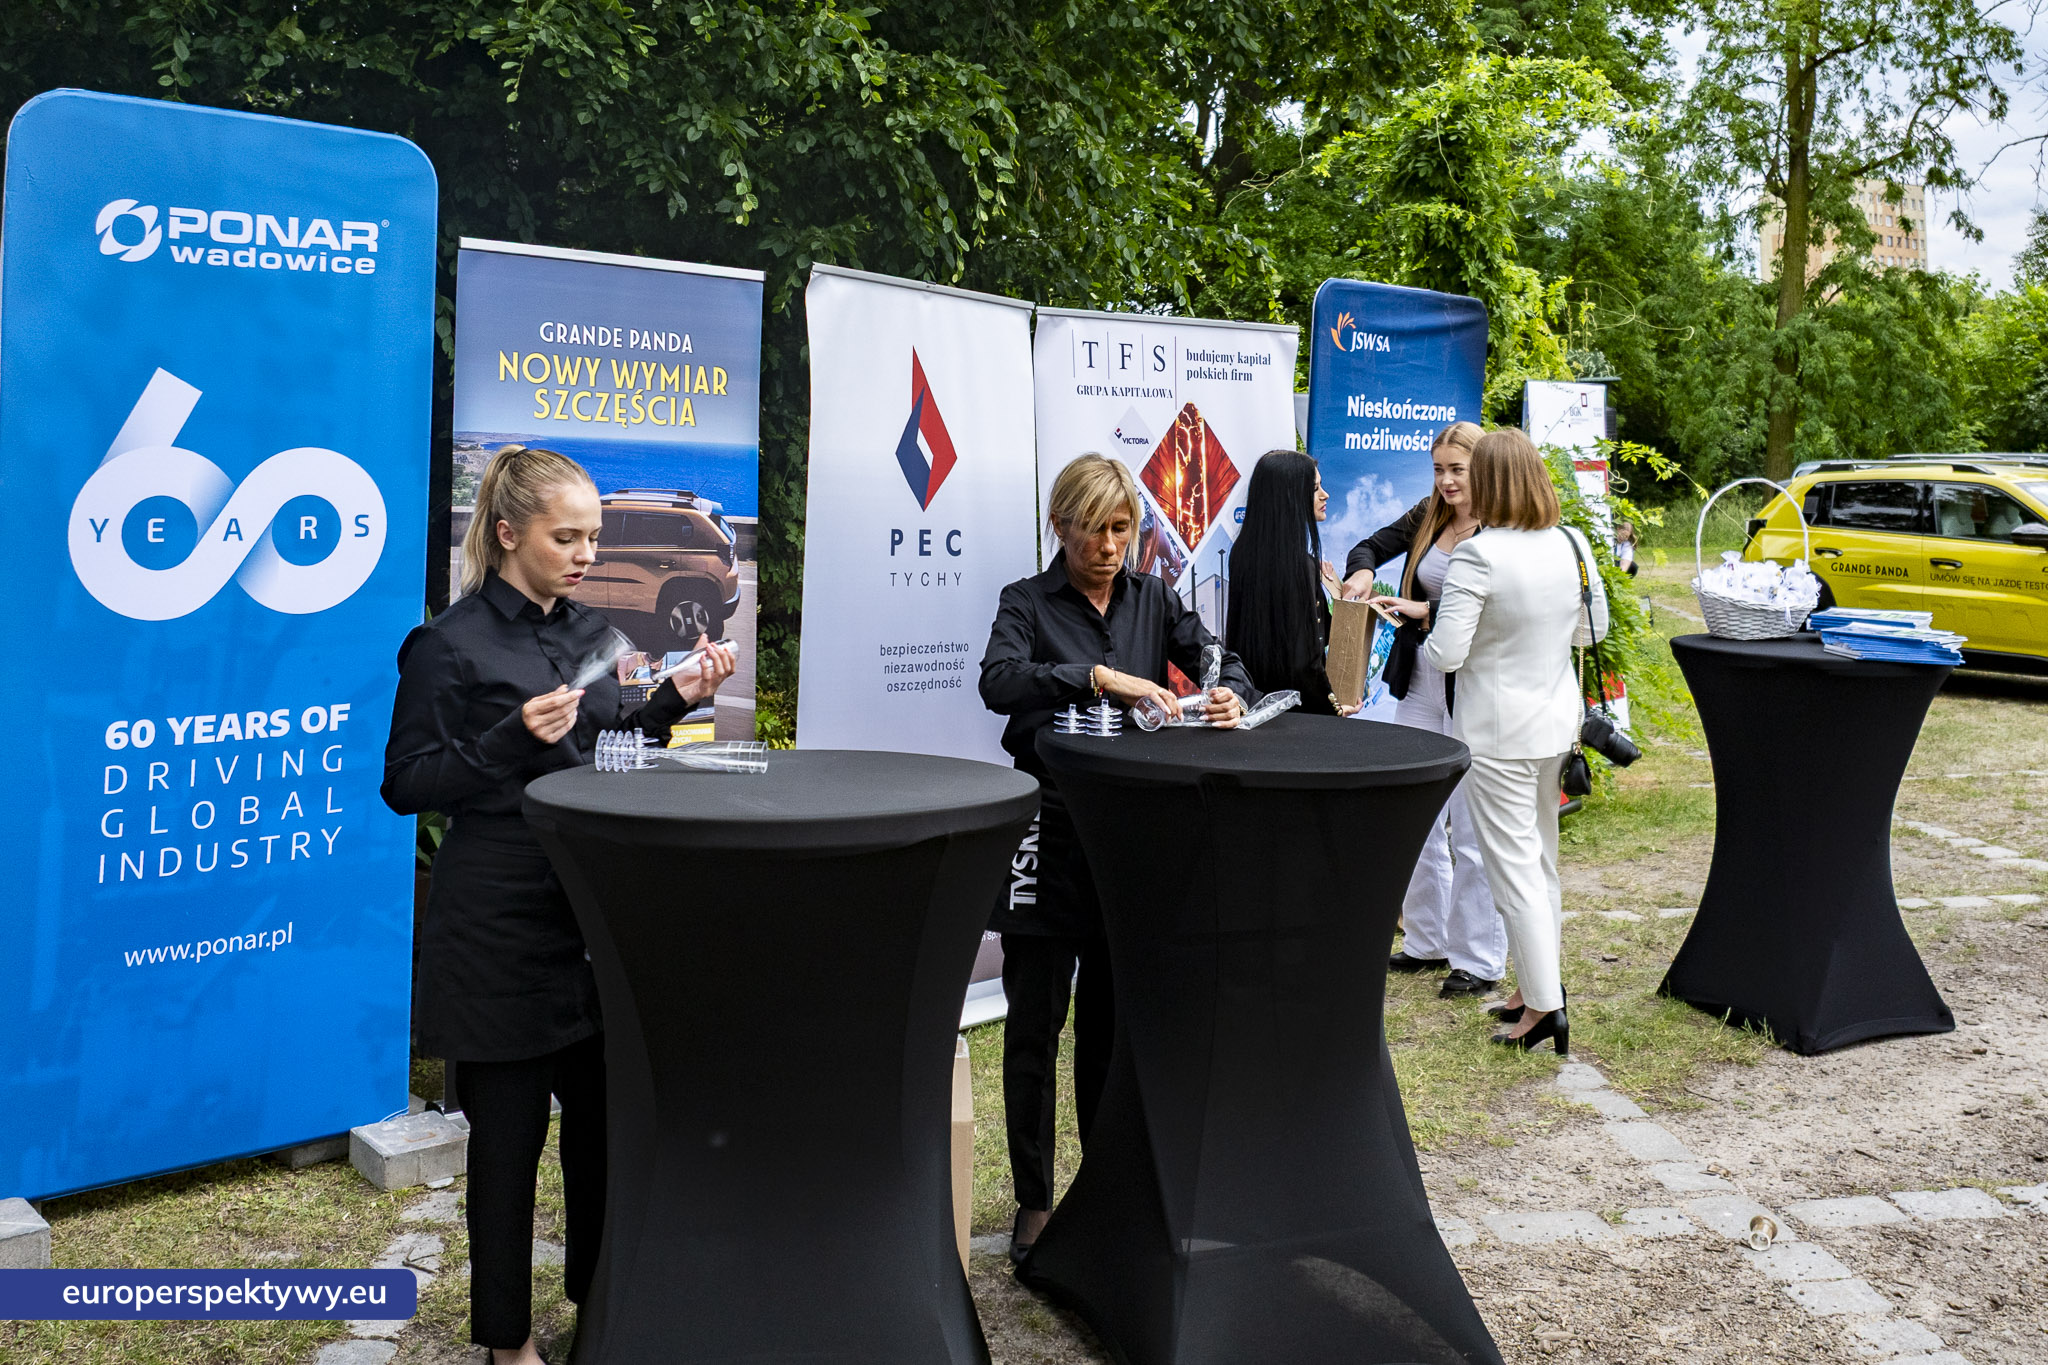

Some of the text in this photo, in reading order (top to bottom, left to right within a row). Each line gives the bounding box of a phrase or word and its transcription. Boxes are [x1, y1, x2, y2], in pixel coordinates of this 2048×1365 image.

[170, 245, 376, 275] wadowice
[539, 321, 693, 354] GRANDE PANDA
[1186, 348, 1271, 366] budujemy kapitał
[499, 350, 728, 396] NOWY WYMIAR
[1186, 366, 1253, 382] polskich firm
[1076, 384, 1174, 399] GRUPA KAPITAŁOWA
[533, 387, 696, 429] SZCZĘŚCIA
[1347, 393, 1457, 422] Nieskończone
[1121, 437, 1150, 445] VICTORIA
[1344, 427, 1434, 452] możliwości
[88, 513, 371, 543] YEARS
[890, 528, 962, 557] PEC
[890, 571, 962, 587] TYCHY
[1830, 561, 1909, 578] GRANDE PANDA
[1929, 572, 1960, 584] UMÓW
[1962, 575, 1976, 586] SIĘ
[1977, 577, 1991, 586] NA
[1993, 578, 2022, 591] JAZDĘ
[880, 641, 969, 658] bezpieczeństwo
[884, 658, 965, 674] niezawodność
[886, 676, 962, 693] oszczędność
[105, 703, 351, 750] 60 YEARS OF
[103, 744, 343, 795] DRIVING
[100, 786, 343, 838] GLOBAL
[98, 826, 343, 884] INDUSTRY
[124, 922, 293, 968] www.ponar.pl
